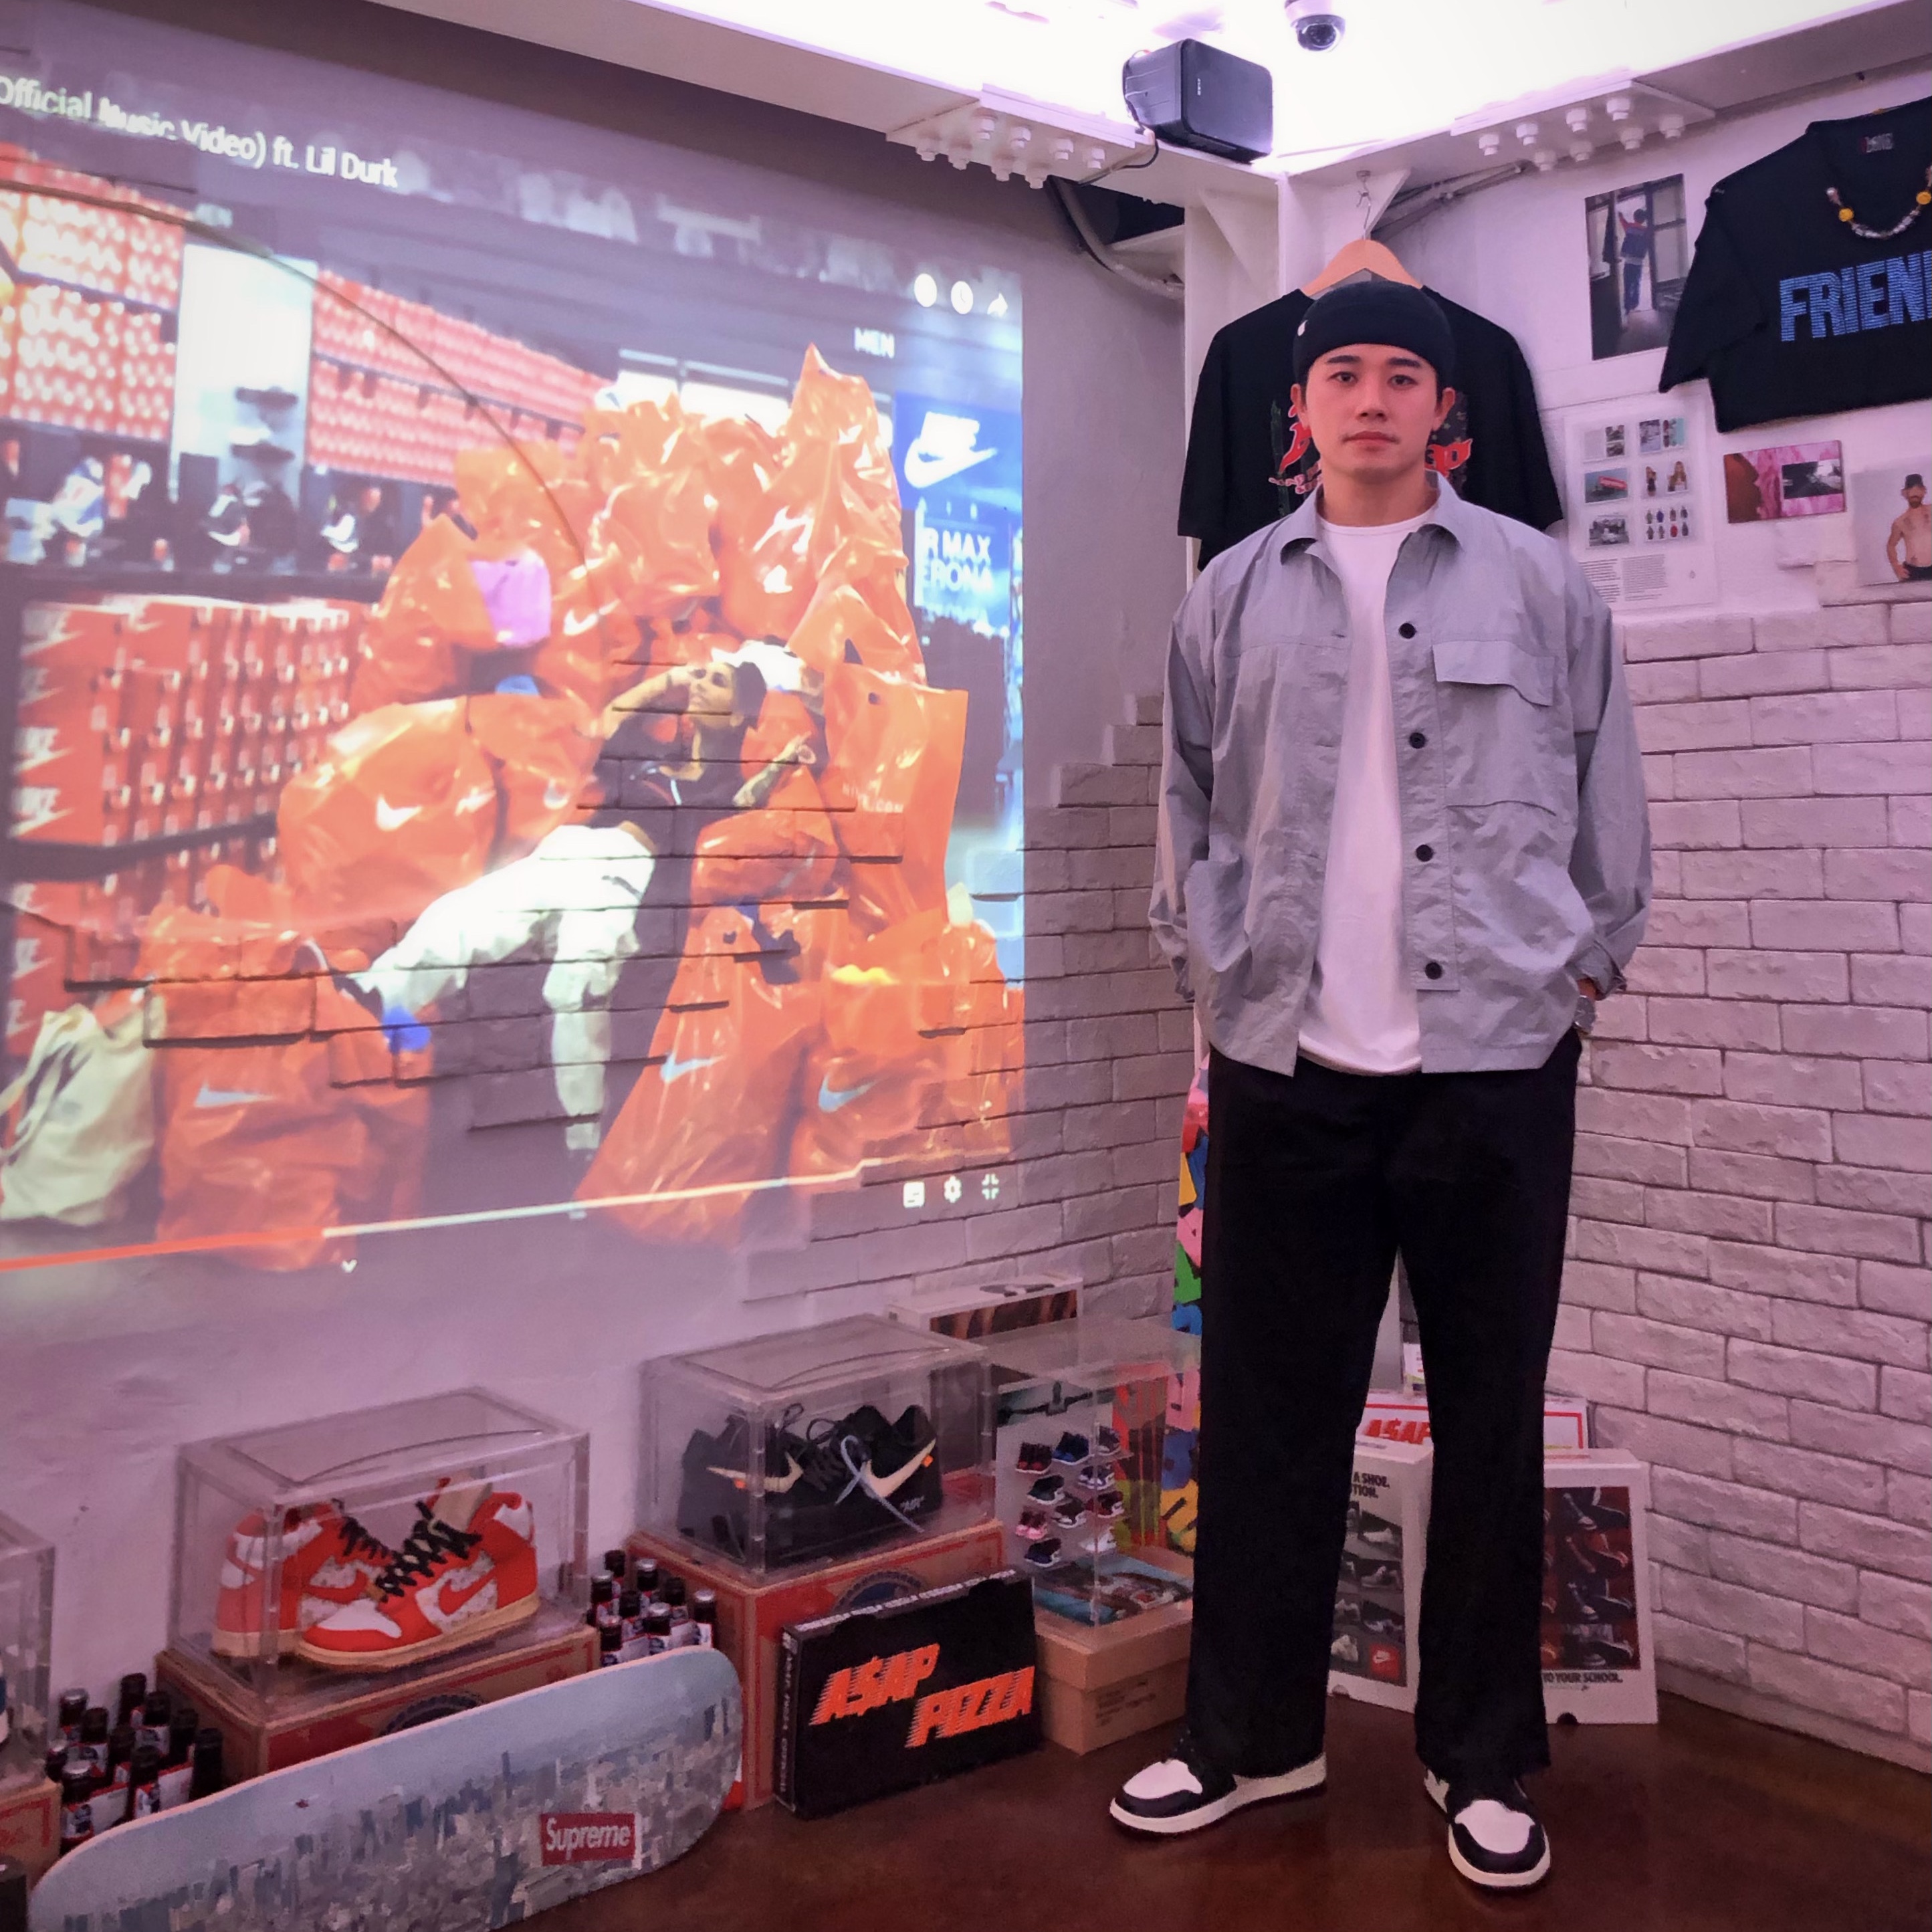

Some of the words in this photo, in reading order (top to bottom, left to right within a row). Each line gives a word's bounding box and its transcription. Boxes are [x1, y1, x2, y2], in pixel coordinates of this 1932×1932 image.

[0, 76, 92, 119] Official
[181, 120, 266, 169] Video)
[272, 136, 300, 169] ft.
[306, 144, 336, 176] Lil
[340, 151, 398, 188] Durk
[942, 529, 992, 565] MAX
[905, 1666, 1035, 1748] PIZZA
[546, 1817, 631, 1860] Supreme
